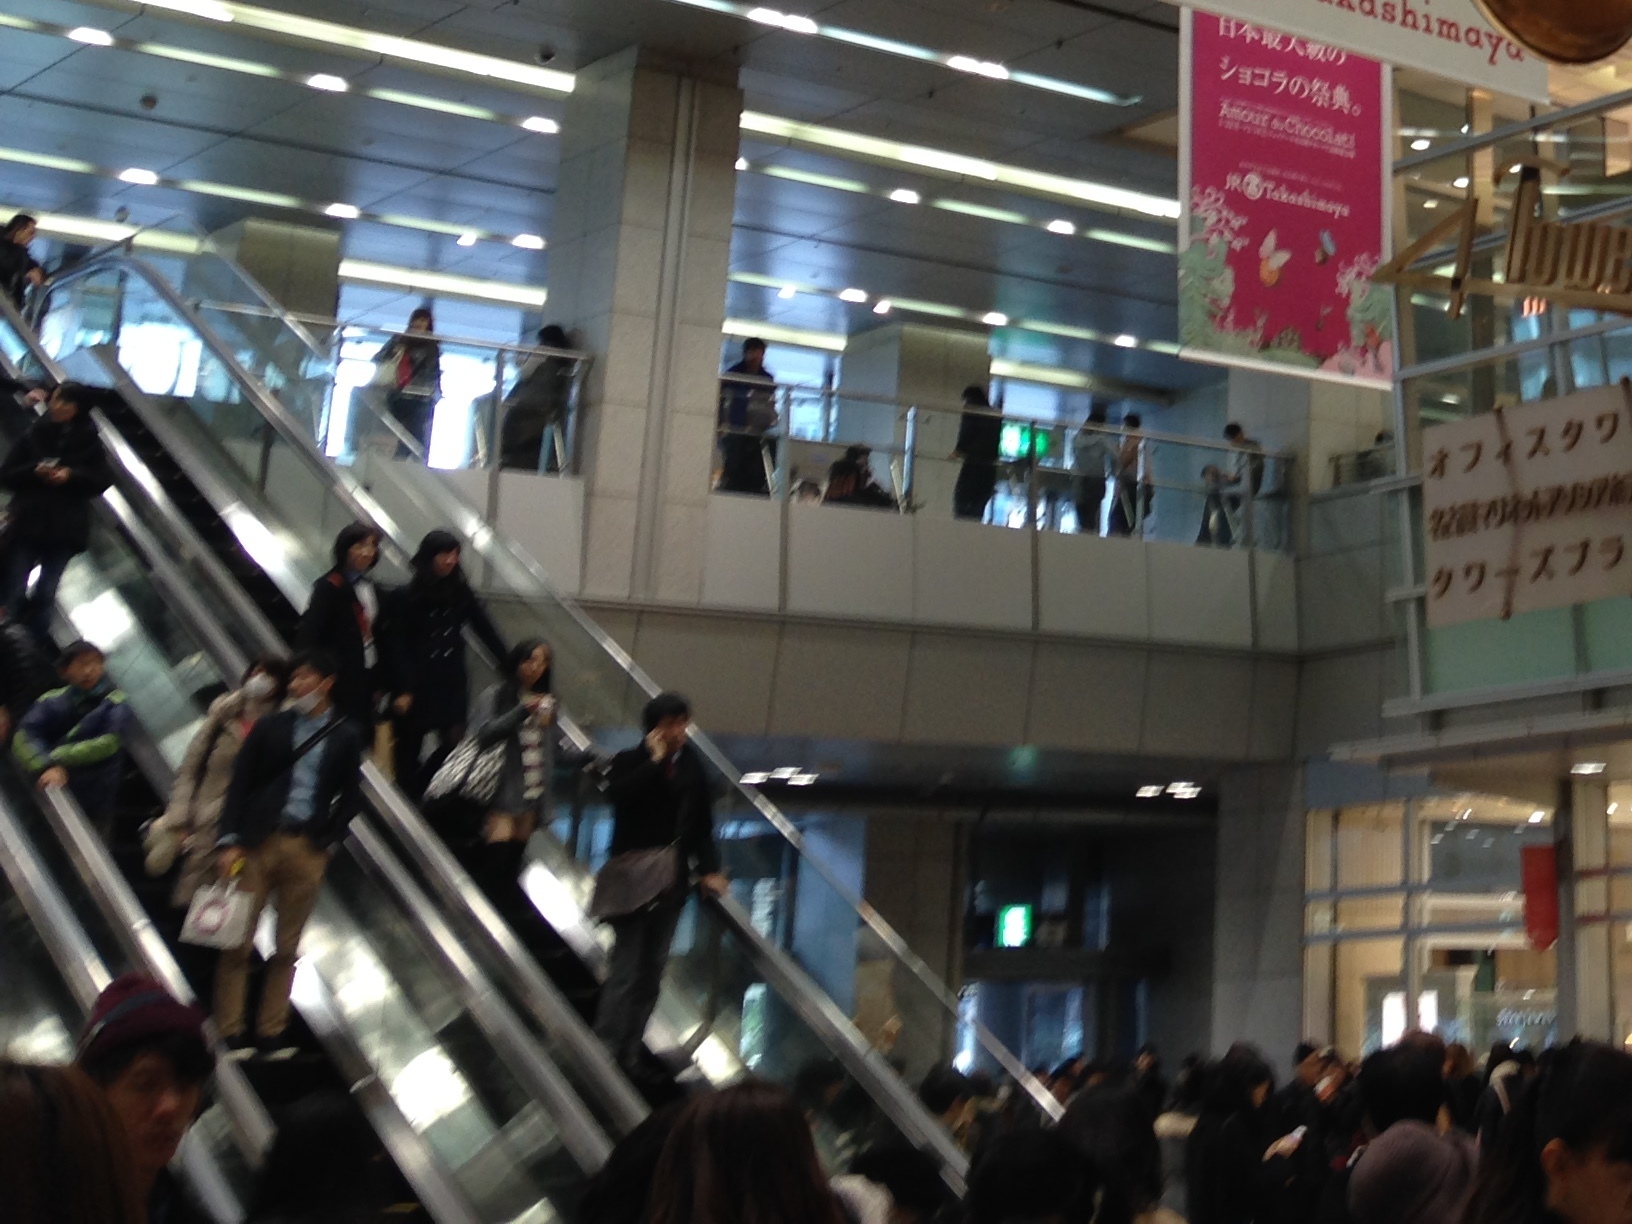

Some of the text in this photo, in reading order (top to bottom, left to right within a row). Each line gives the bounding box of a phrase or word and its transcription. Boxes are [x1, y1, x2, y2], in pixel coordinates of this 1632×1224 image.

[1219, 54, 1362, 117] ショコラの祭典。
[1263, 180, 1351, 219] Takashimaya
